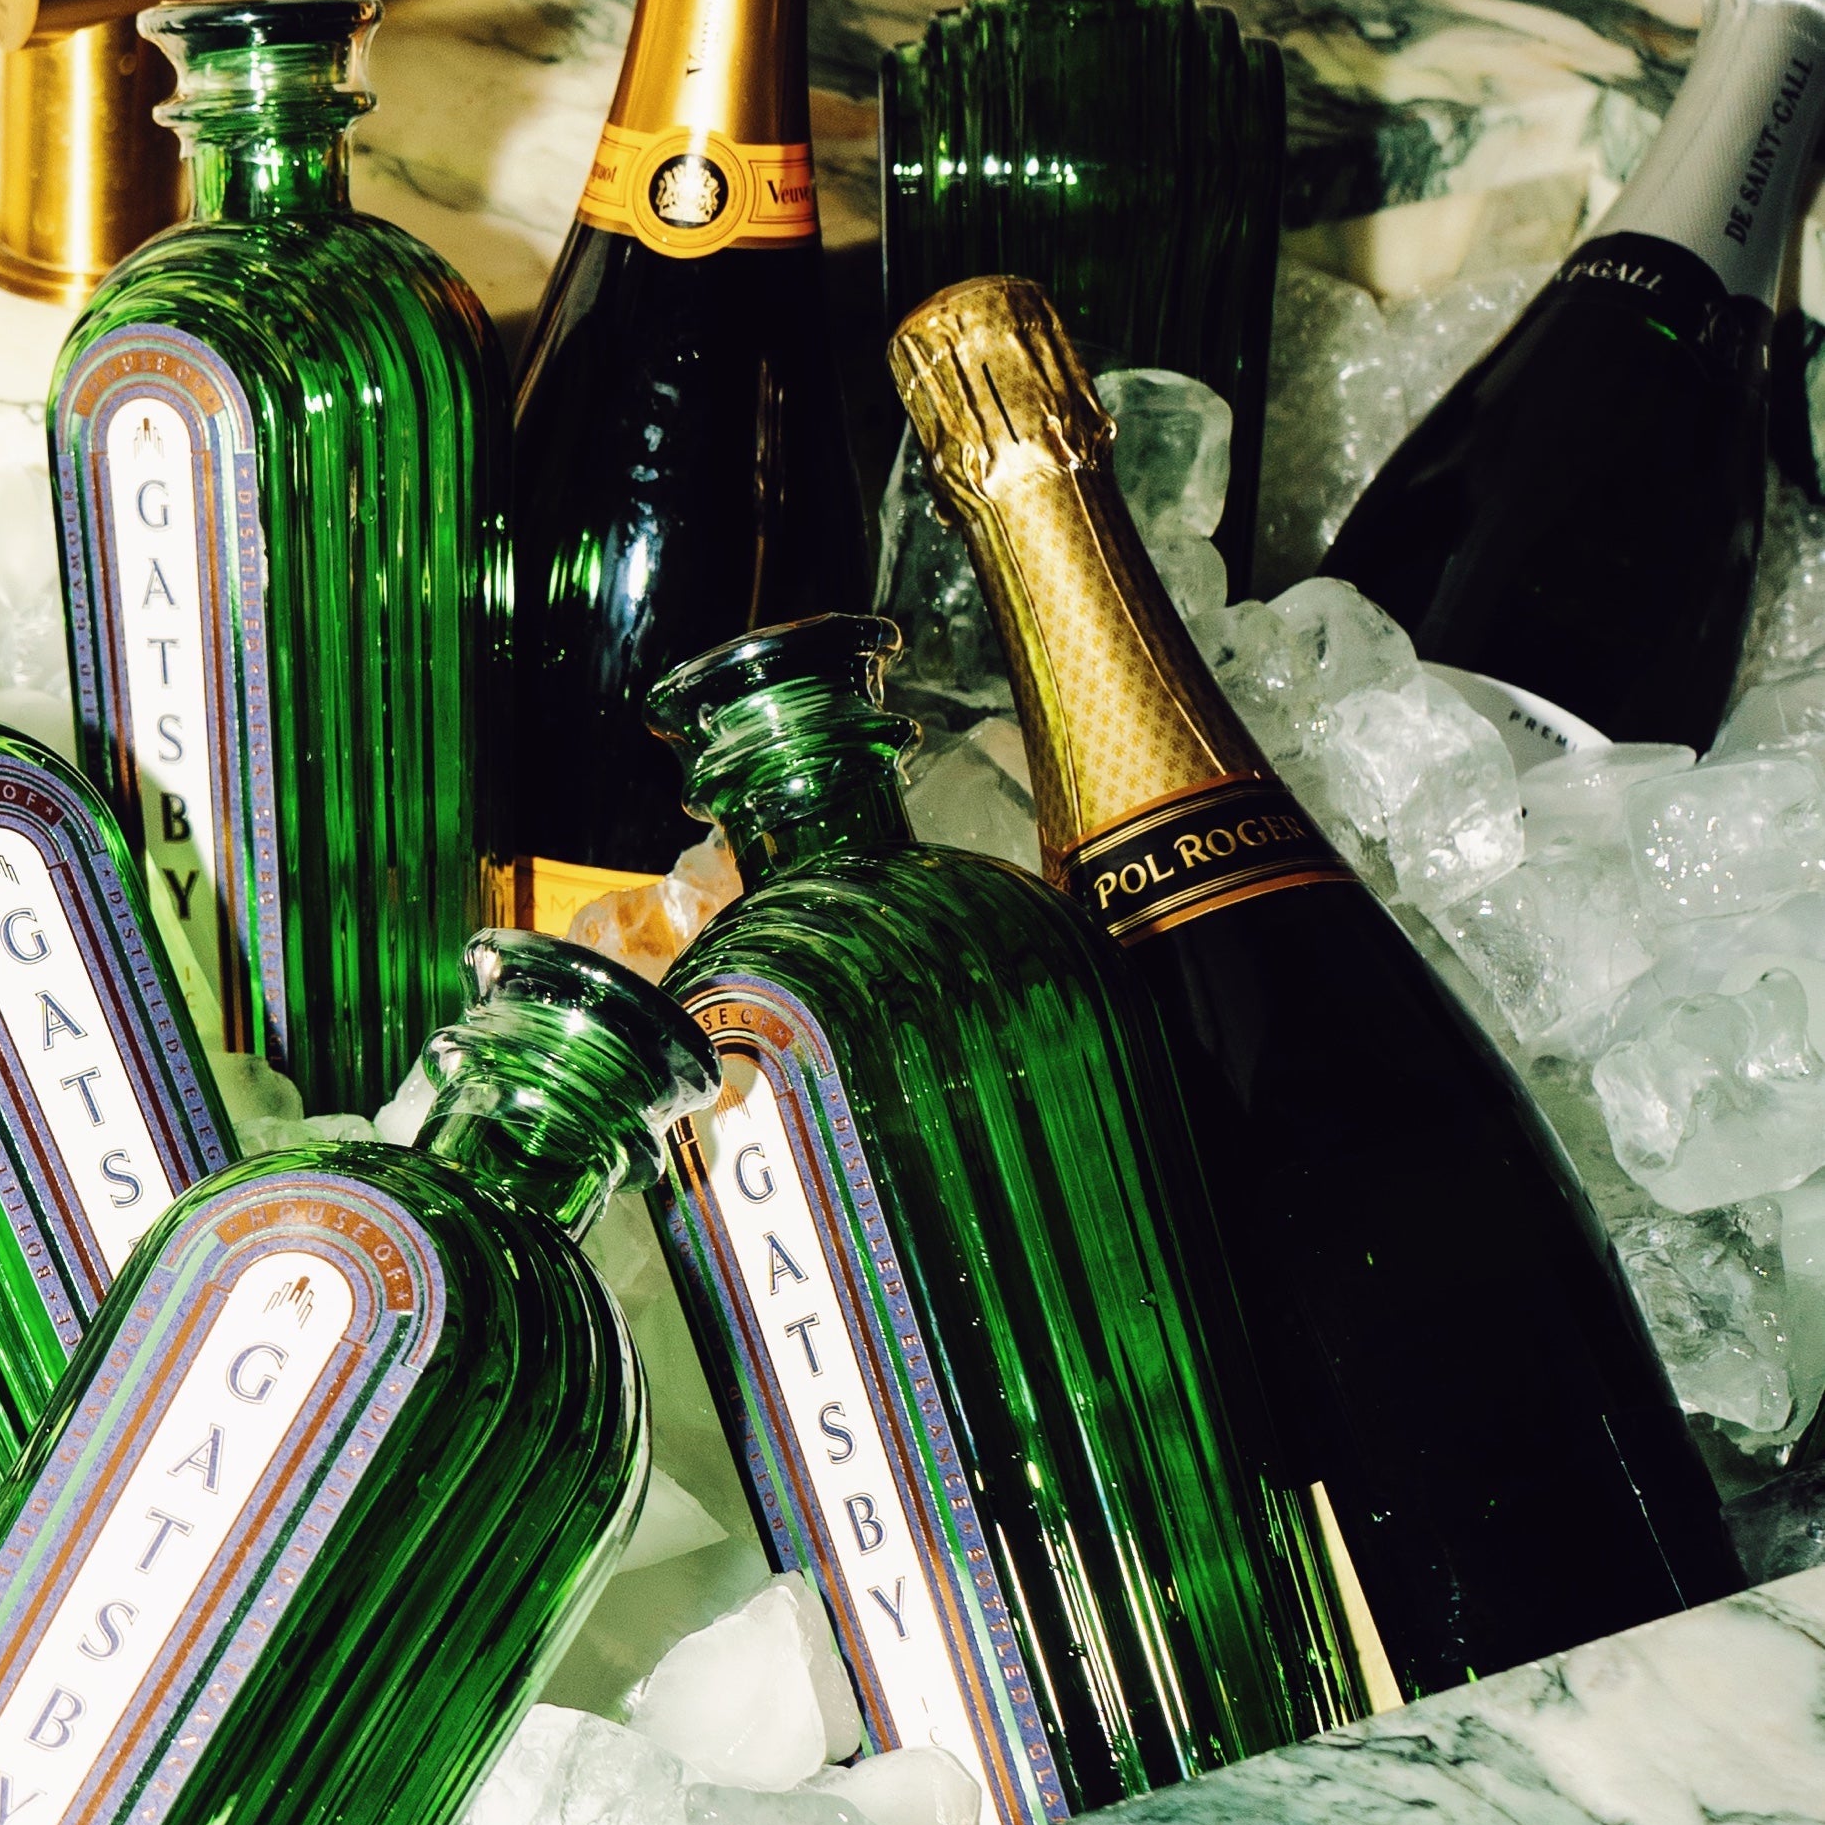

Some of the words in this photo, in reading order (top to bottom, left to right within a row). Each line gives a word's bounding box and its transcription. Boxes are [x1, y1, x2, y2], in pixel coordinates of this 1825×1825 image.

[1725, 205, 1754, 247] DE
[63, 489, 87, 630] GLAMOUR
[236, 490, 260, 650] DISTILLED
[136, 479, 200, 921] GATSBY
[248, 684, 271, 839] ELEGANCE
[2, 785, 37, 806] OF
[1094, 853, 1175, 910] POL
[1174, 815, 1308, 869] ROGER
[255, 870, 284, 1000] BOTTLED
[0, 908, 143, 1208] GATS
[103, 889, 181, 1054] DISTILLED
[181, 1085, 223, 1162] ELEG
[249, 1204, 371, 1239] HOUSE
[374, 1244, 406, 1280] OF
[57, 1304, 154, 1465] GLAMOUR
[726, 1384, 788, 1530] BOTTLED
[735, 1144, 909, 1641] GATSBY
[833, 1115, 901, 1298] DISTILLED
[899, 1330, 967, 1511] ELEGANCE
[965, 1546, 1028, 1705] BOTTLED
[276, 1403, 390, 1587] DISTILLED
[154, 1617, 267, 1797] ELEGANCE
